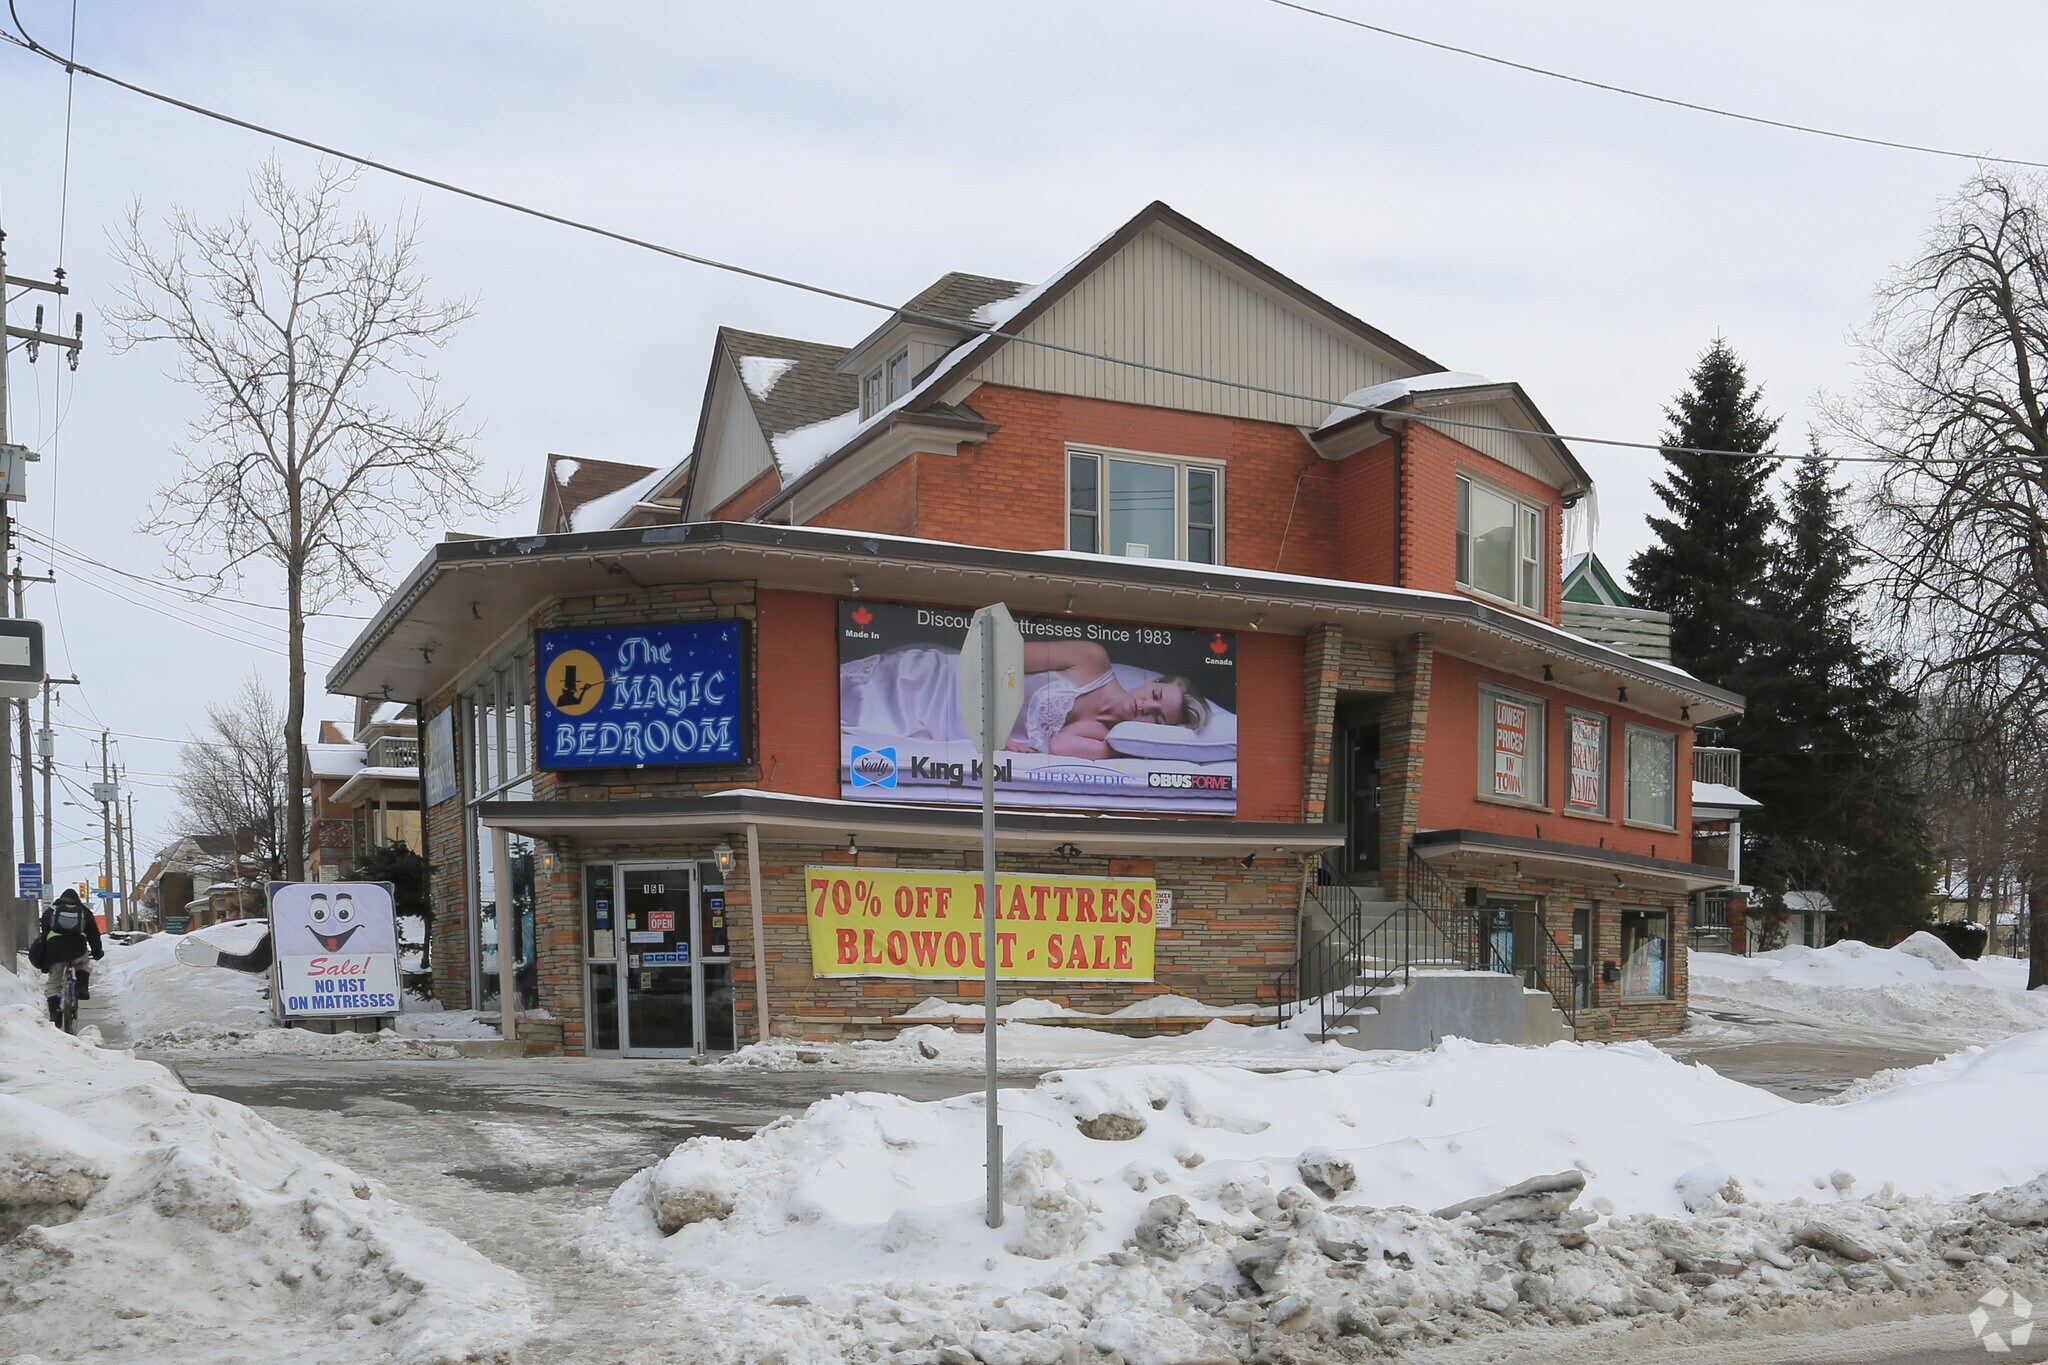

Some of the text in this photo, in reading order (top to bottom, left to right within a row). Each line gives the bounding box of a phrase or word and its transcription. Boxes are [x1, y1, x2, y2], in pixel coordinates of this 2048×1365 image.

[845, 629, 880, 640] Made In
[1087, 624, 1130, 642] Since
[1135, 628, 1172, 646] 1983
[617, 637, 672, 672] The
[1205, 656, 1233, 666] Canada
[609, 670, 726, 718] MAGIC
[1496, 704, 1525, 729] LOWEST
[554, 715, 735, 761] BEDROOM
[1496, 728, 1523, 753] PRICES
[856, 757, 889, 776] Sealy
[1505, 757, 1515, 772] IN
[1571, 741, 1599, 772] BRAND
[911, 756, 964, 787] King
[1025, 771, 1132, 787] THERAPEDIC
[1496, 771, 1521, 794] TOWN
[644, 884, 665, 894] 151
[810, 879, 1153, 924] 70% OFF MATTRESS
[651, 919, 673, 929] OPEN
[836, 927, 1017, 968] BLOWOUT
[1047, 933, 1134, 970] SALE
[307, 956, 372, 977] Sale!
[315, 978, 367, 993] NO HST
[288, 993, 395, 1011] ON MATRESSES
